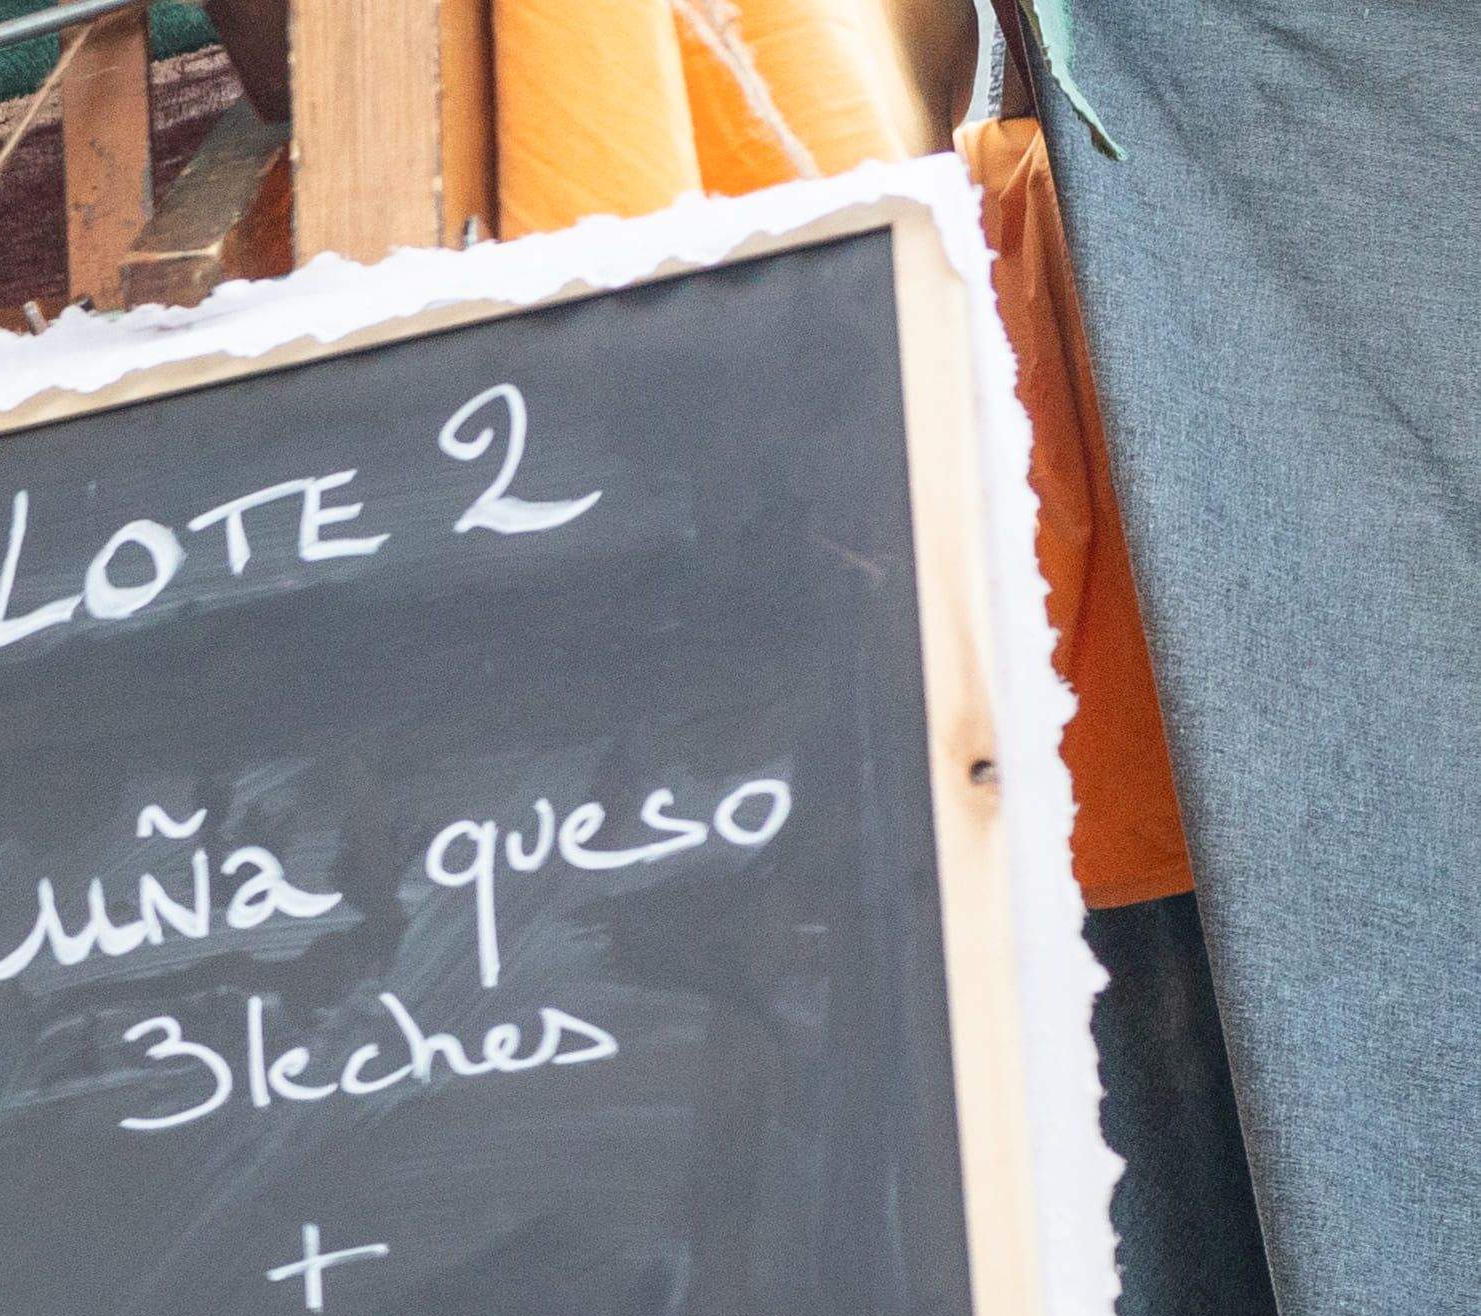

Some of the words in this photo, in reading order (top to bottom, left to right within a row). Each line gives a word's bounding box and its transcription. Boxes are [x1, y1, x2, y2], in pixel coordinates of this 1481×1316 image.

[439, 384, 603, 536] 2
[424, 777, 792, 989] queso
[266, 1223, 390, 1313] +
